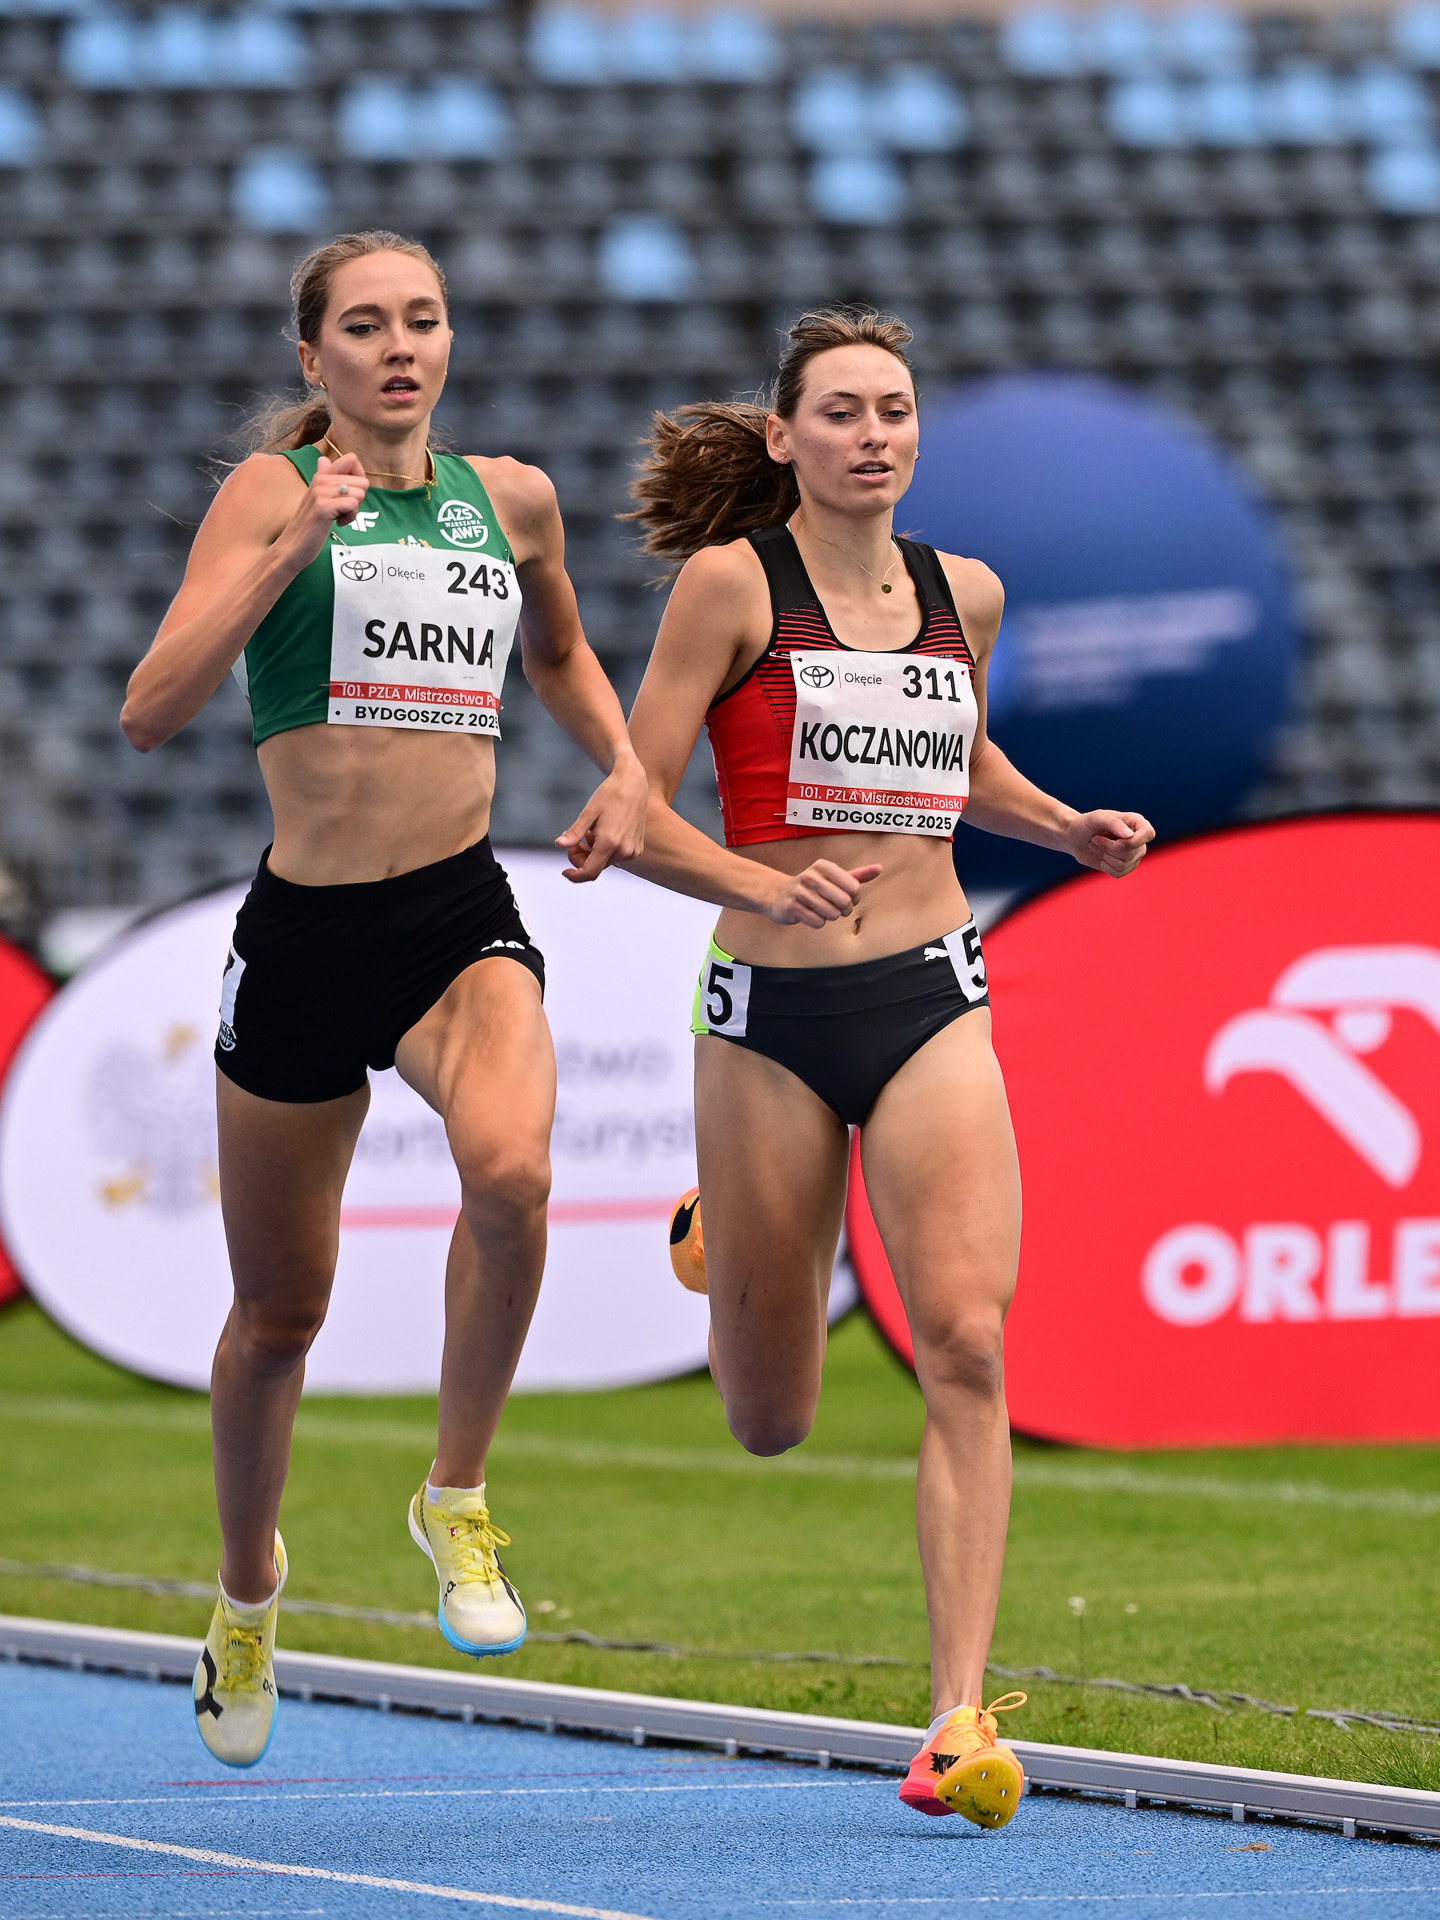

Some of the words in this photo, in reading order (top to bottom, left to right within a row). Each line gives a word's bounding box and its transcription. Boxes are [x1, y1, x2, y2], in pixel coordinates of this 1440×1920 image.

[445, 519, 481, 528] WARSZAWA
[447, 508, 473, 521] AZS
[451, 526, 482, 541] AWF
[387, 566, 425, 581] Okęcie
[446, 562, 509, 600] 243
[363, 619, 494, 669] SARNA
[342, 684, 364, 698] 101.
[368, 687, 401, 700] PZLA
[404, 688, 483, 706] Mistrzostwa
[844, 673, 882, 686] Okęcie
[902, 665, 961, 703] 311
[355, 706, 464, 726] BYDGOSZCZ
[799, 722, 964, 772] KOCZANOWA
[800, 786, 822, 799] 101.
[826, 789, 858, 802] PZLA
[862, 792, 931, 807] Mistrzostwa
[933, 797, 963, 810] Polski
[812, 807, 914, 827] BYDGOSZCZ
[917, 815, 952, 830] 2025
[962, 926, 988, 988] 5
[707, 962, 734, 1026] 5
